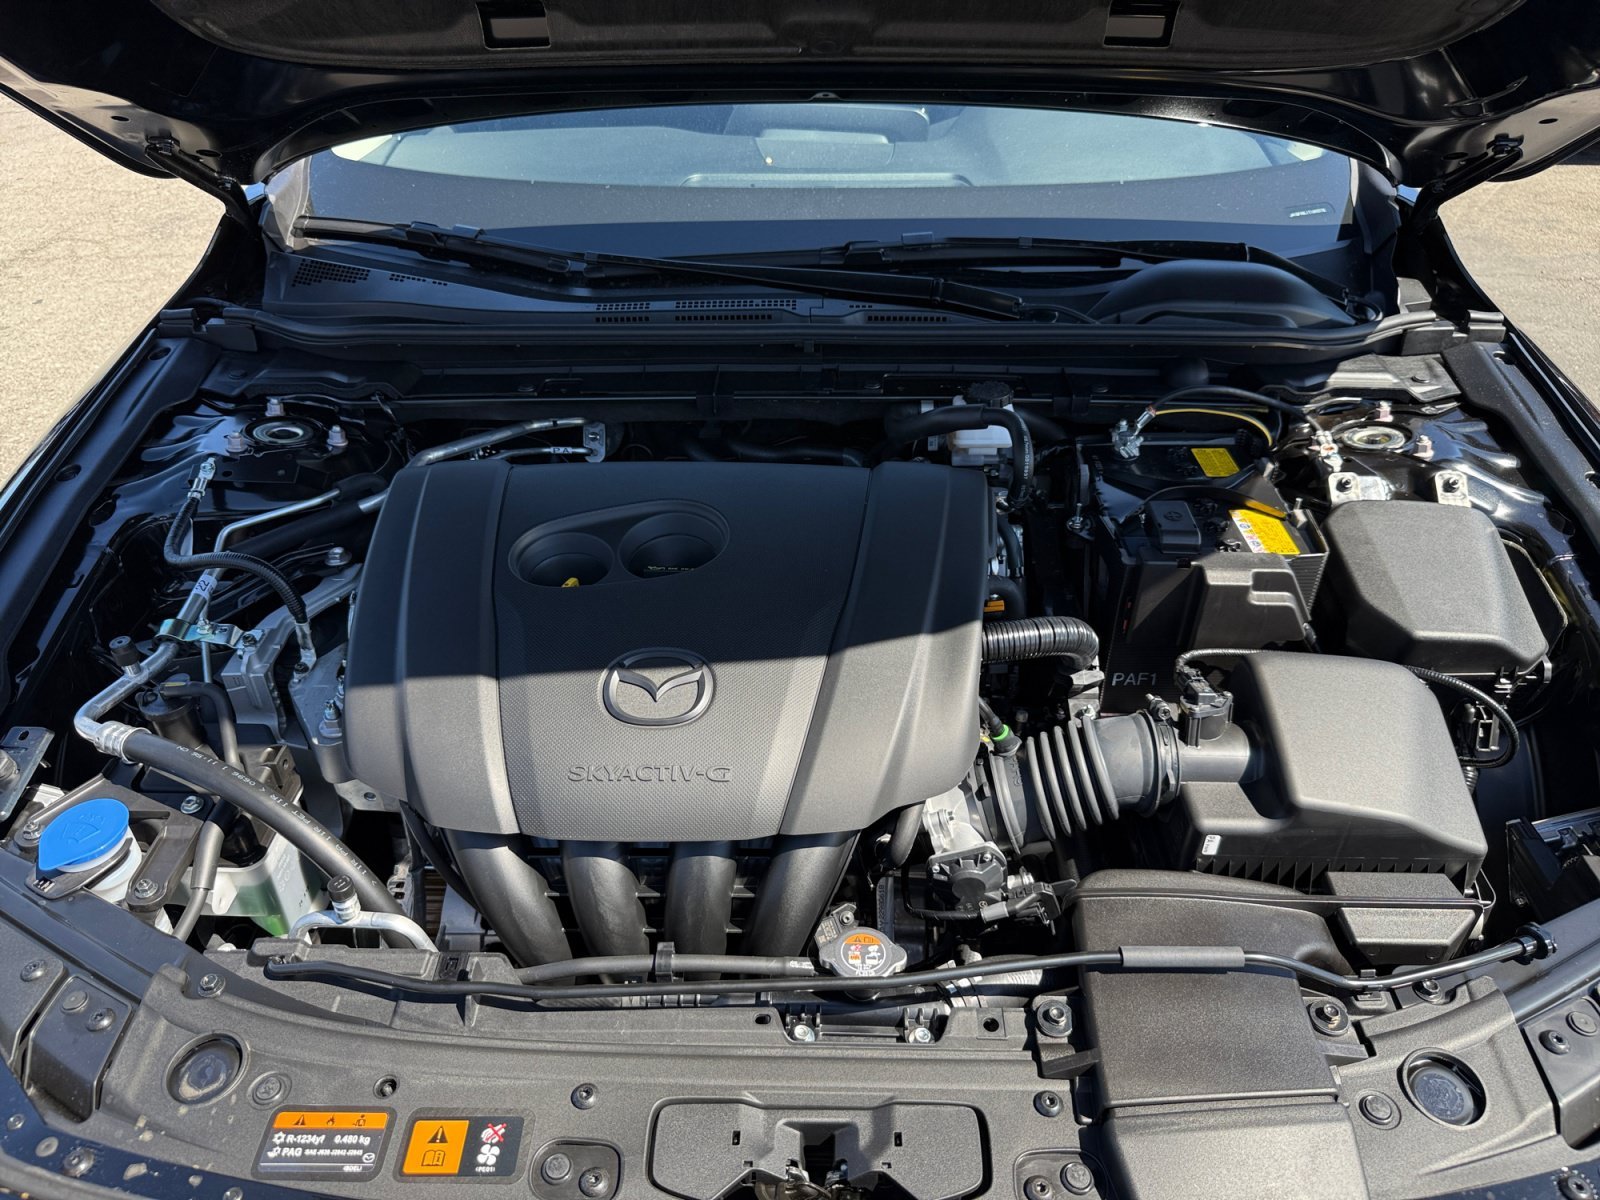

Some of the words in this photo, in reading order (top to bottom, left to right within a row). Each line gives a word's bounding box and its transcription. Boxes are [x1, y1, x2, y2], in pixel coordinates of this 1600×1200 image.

[1111, 672, 1157, 686] PAF1
[567, 765, 732, 783] SKYACTIV-G
[291, 810, 311, 825] PET
[335, 844, 349, 857] PA
[286, 1134, 326, 1146] R-1234yf
[334, 1134, 357, 1144] 0.480
[358, 1134, 371, 1146] kg
[281, 1147, 302, 1157] PAG
